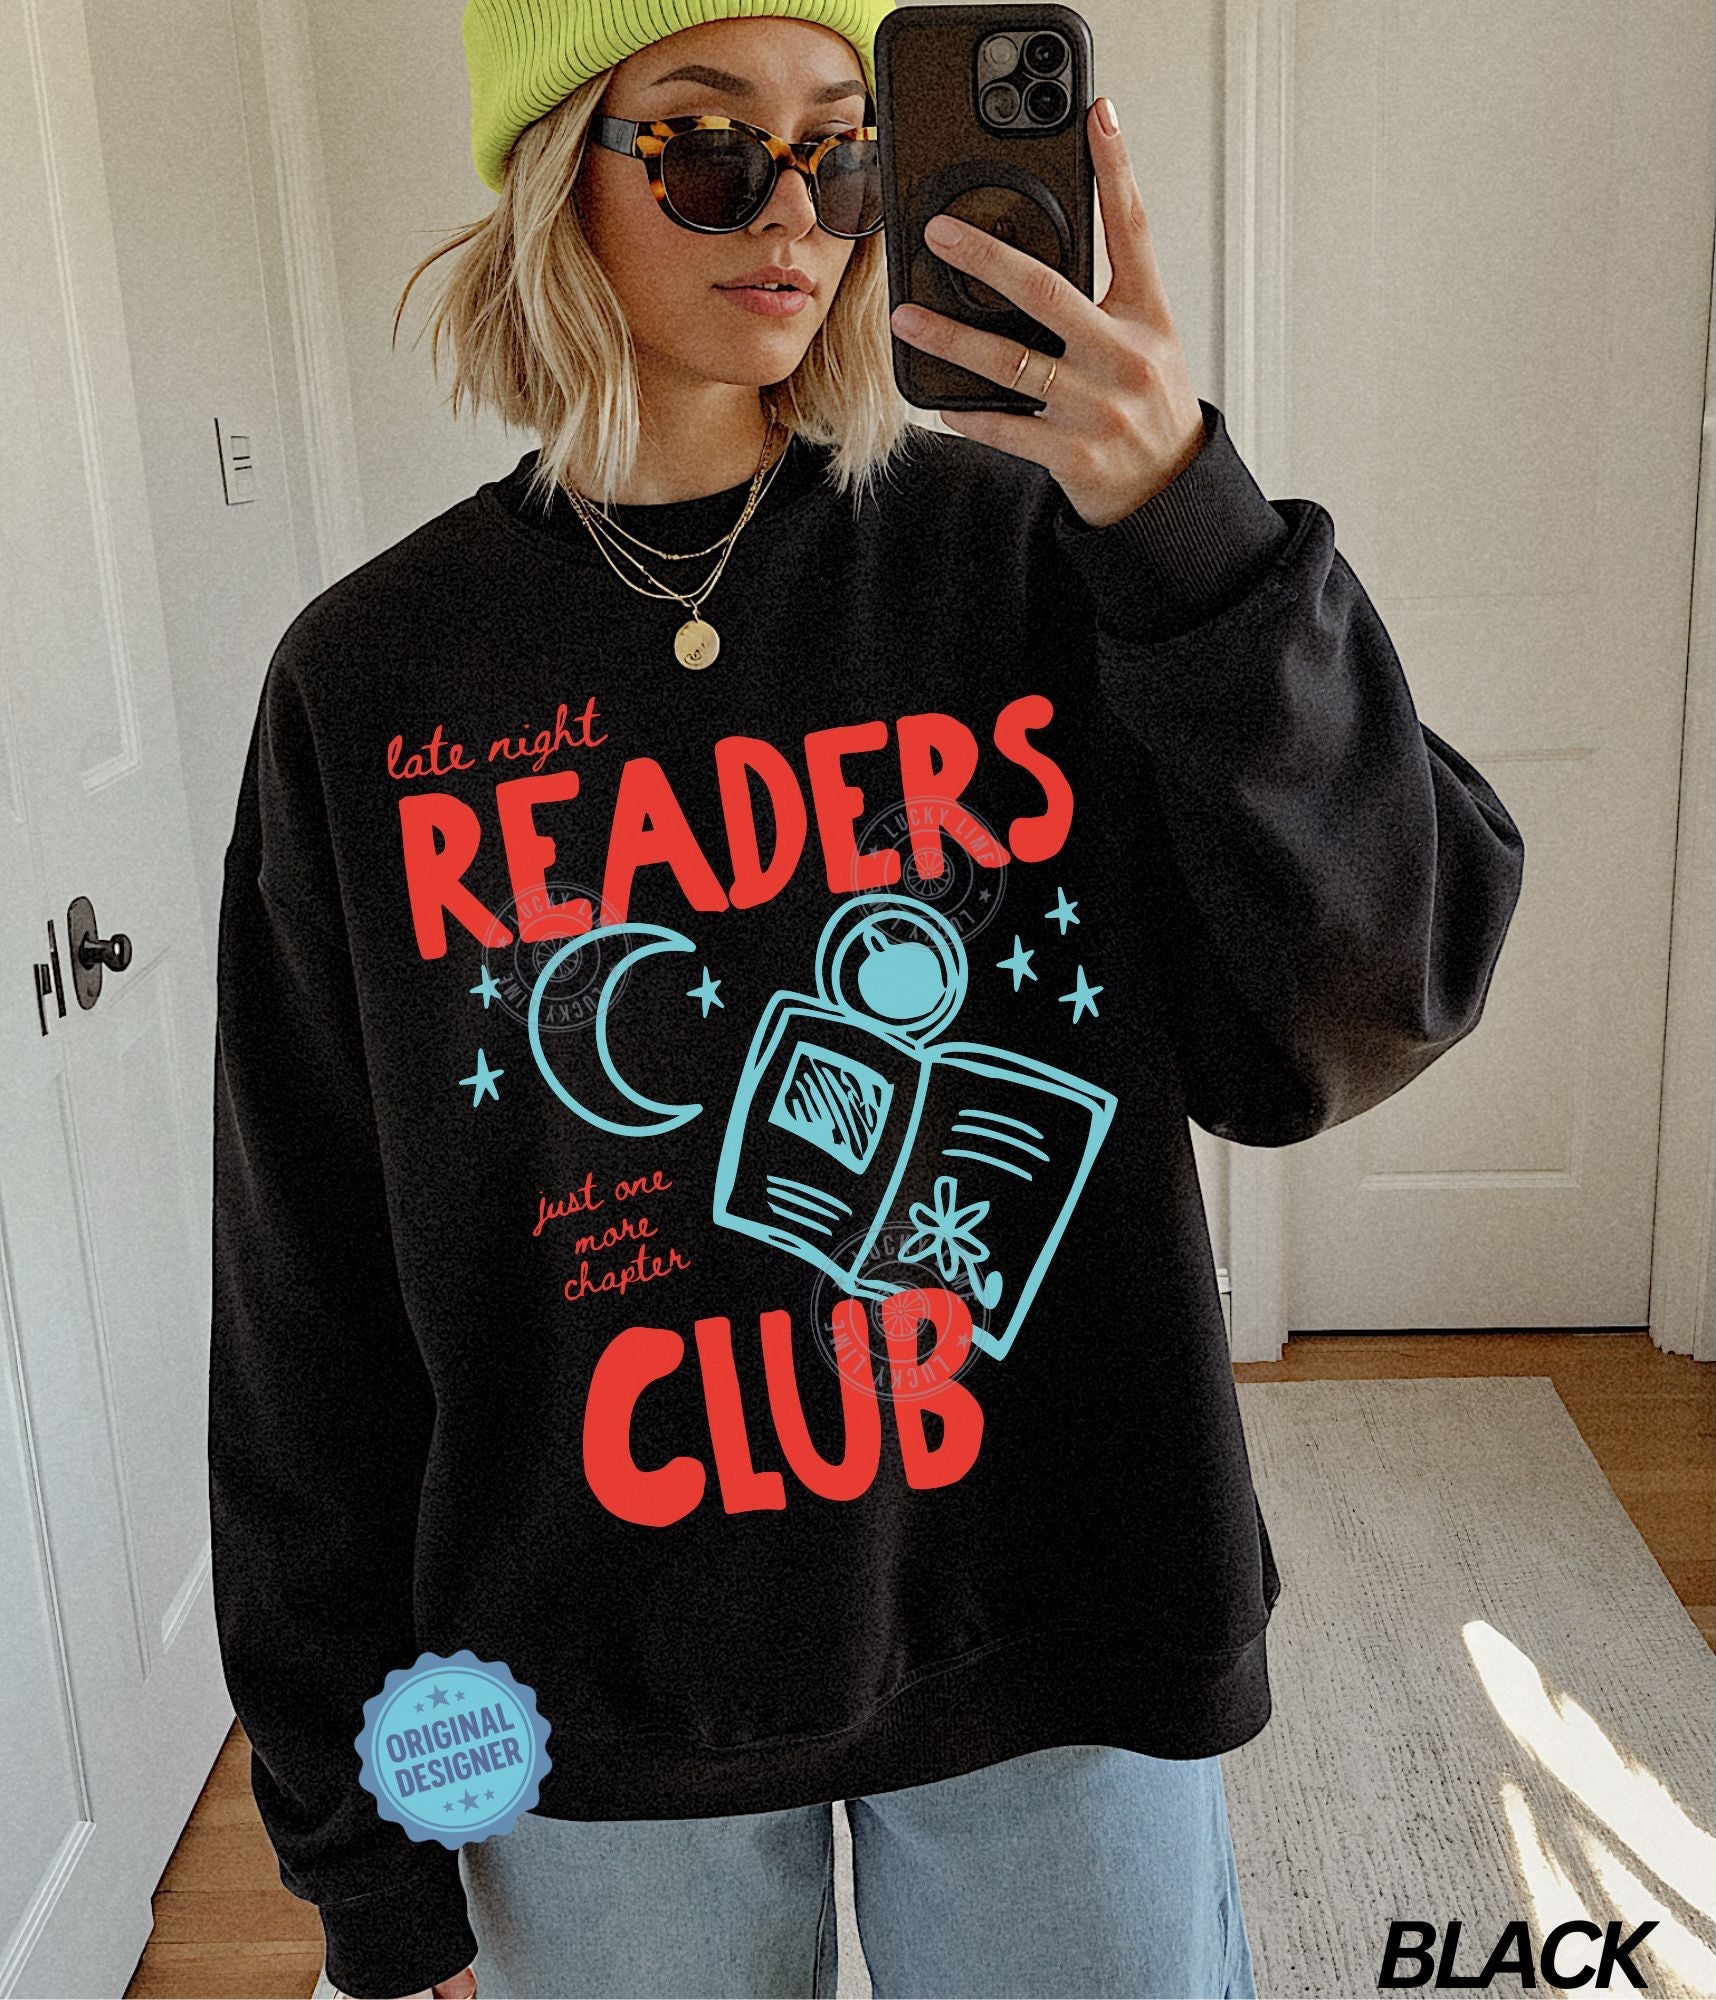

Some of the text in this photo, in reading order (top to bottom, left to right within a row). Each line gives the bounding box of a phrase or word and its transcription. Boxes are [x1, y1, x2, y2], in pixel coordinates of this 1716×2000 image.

[388, 697, 608, 779] late night
[399, 695, 1075, 961] READERS
[533, 1170, 673, 1237] just one
[575, 1217, 658, 1254] more
[564, 1244, 692, 1301] chapter
[583, 1288, 985, 1528] CLUB
